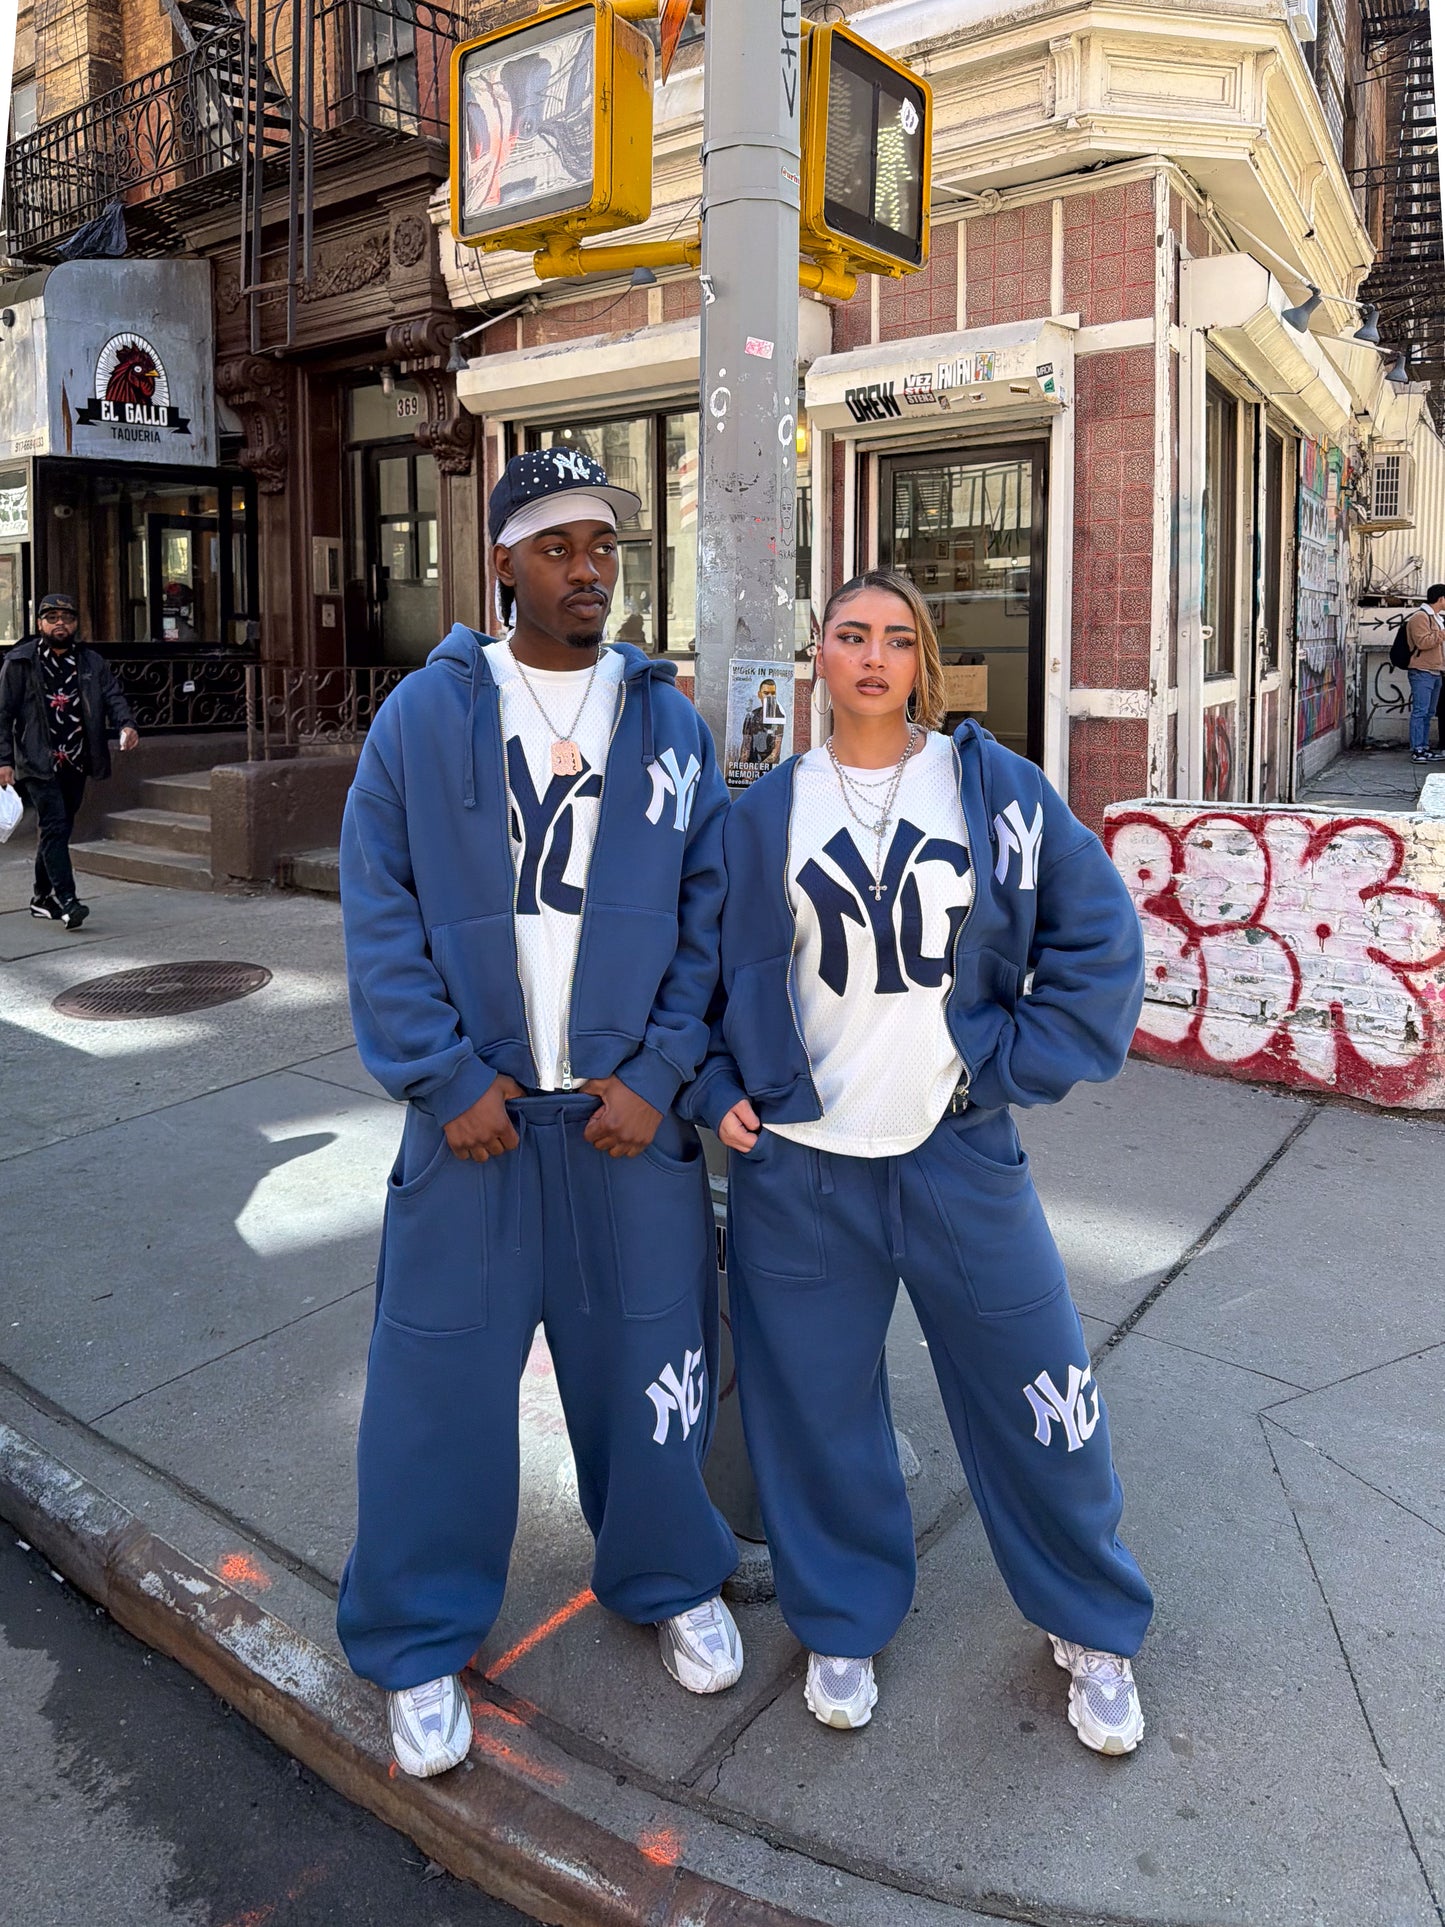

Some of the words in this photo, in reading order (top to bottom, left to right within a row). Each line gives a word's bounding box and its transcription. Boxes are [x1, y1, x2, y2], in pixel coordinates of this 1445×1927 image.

[398, 396, 417, 416] 369
[845, 381, 902, 423] DREW
[101, 400, 119, 421] EL
[125, 403, 168, 426] GALLO
[111, 427, 161, 443] TAQUERIA
[732, 666, 756, 676] WORK
[757, 667, 766, 677] IN
[728, 761, 770, 771] PREORDER
[728, 770, 760, 779] MEMOIR
